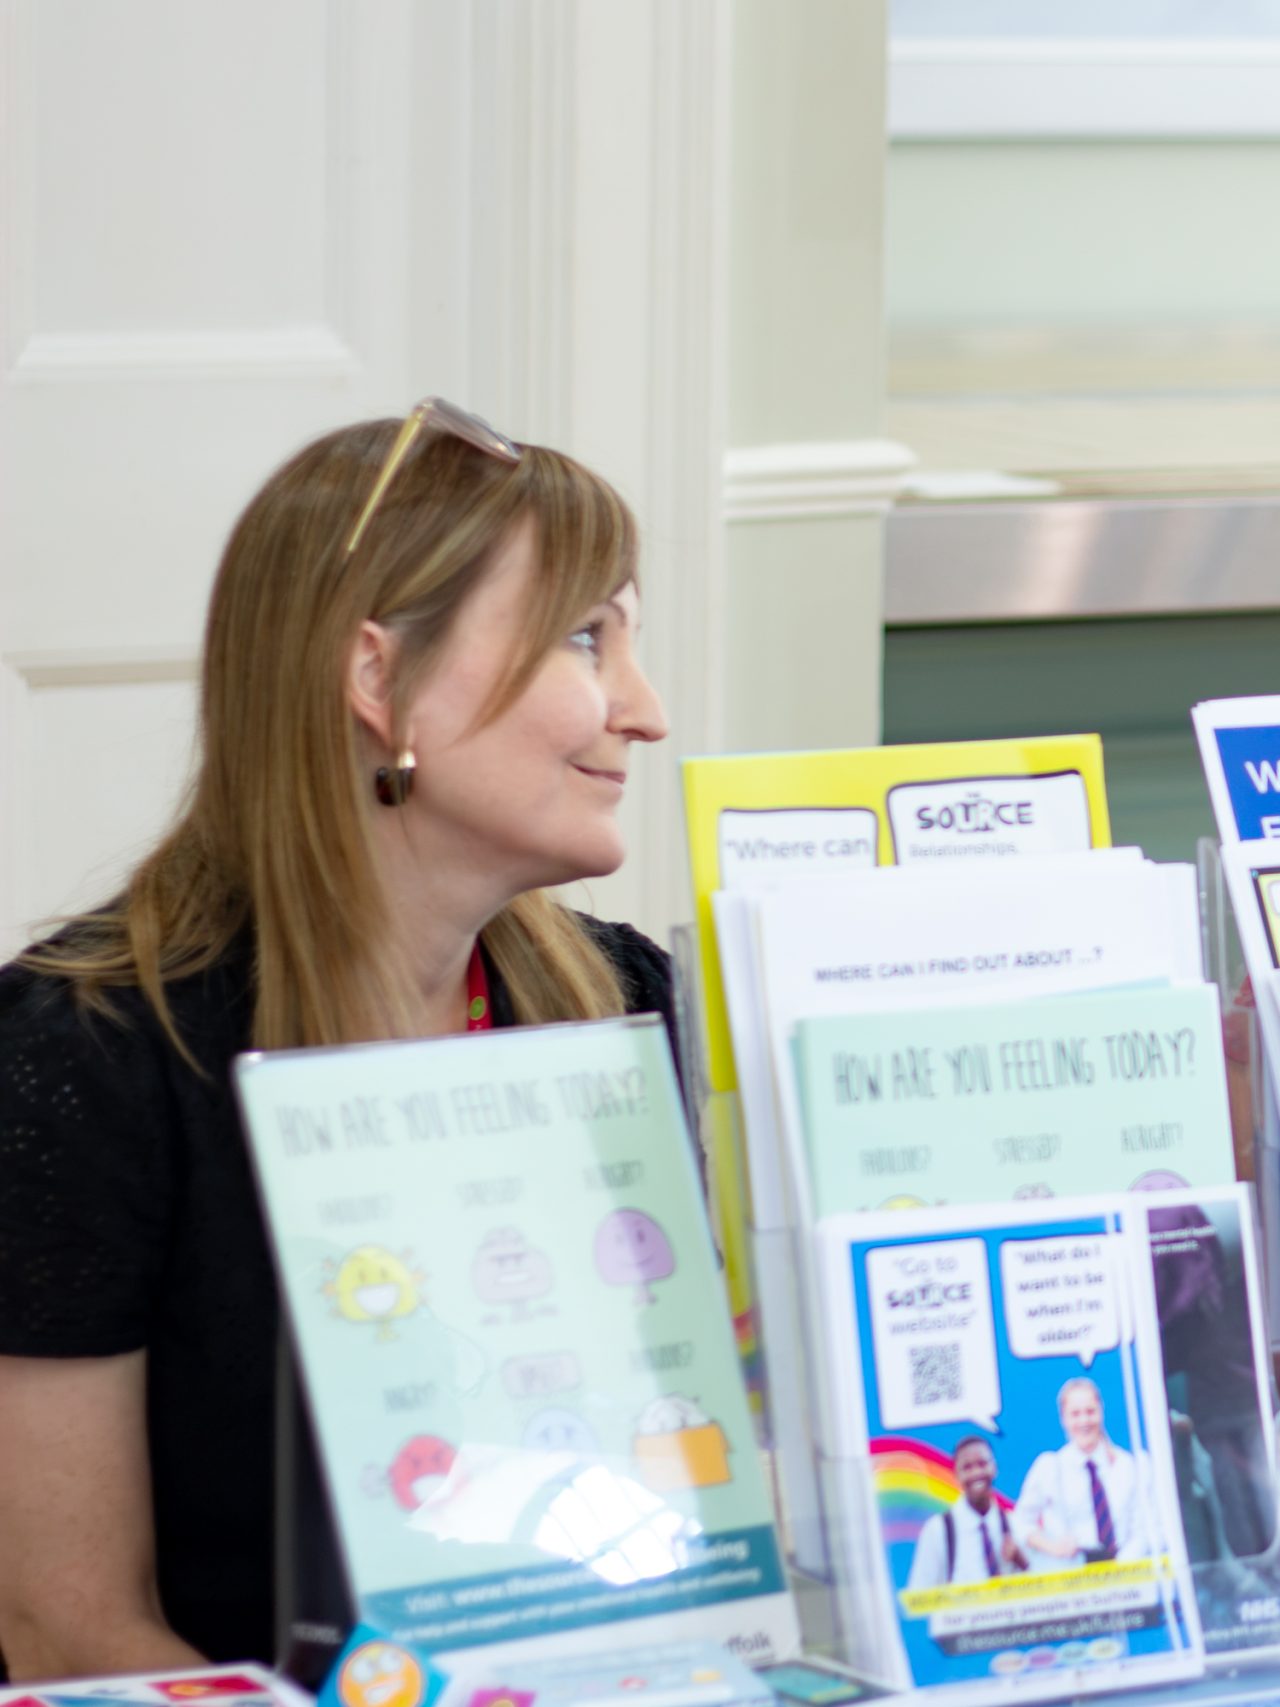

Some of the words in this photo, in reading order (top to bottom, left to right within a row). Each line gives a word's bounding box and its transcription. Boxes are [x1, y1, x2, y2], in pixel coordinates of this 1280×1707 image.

[823, 838, 870, 858] can
[815, 964, 872, 982] WHERE
[878, 961, 914, 978] CAN
[918, 960, 926, 976] I
[928, 956, 968, 975] FIND
[972, 953, 1009, 971] OUT
[1013, 948, 1074, 968] ABOUT
[832, 1045, 884, 1106] HOW
[890, 1044, 936, 1102] ARE
[943, 1043, 994, 1096] YOU
[997, 1035, 1097, 1092] FEELING
[1102, 1026, 1197, 1083] TODAY?
[275, 1102, 333, 1158] HOW
[338, 1093, 392, 1151] ARE
[394, 1090, 449, 1142] YOU
[450, 1079, 553, 1136] FEELING
[554, 1065, 650, 1123] TODAY?
[934, 1255, 959, 1273] to
[1017, 1275, 1059, 1292] want
[1063, 1274, 1080, 1287] to
[1084, 1270, 1105, 1284] be
[1026, 1302, 1071, 1318] when
[1019, 1598, 1069, 1616] people
[1241, 1597, 1280, 1622] NHS
